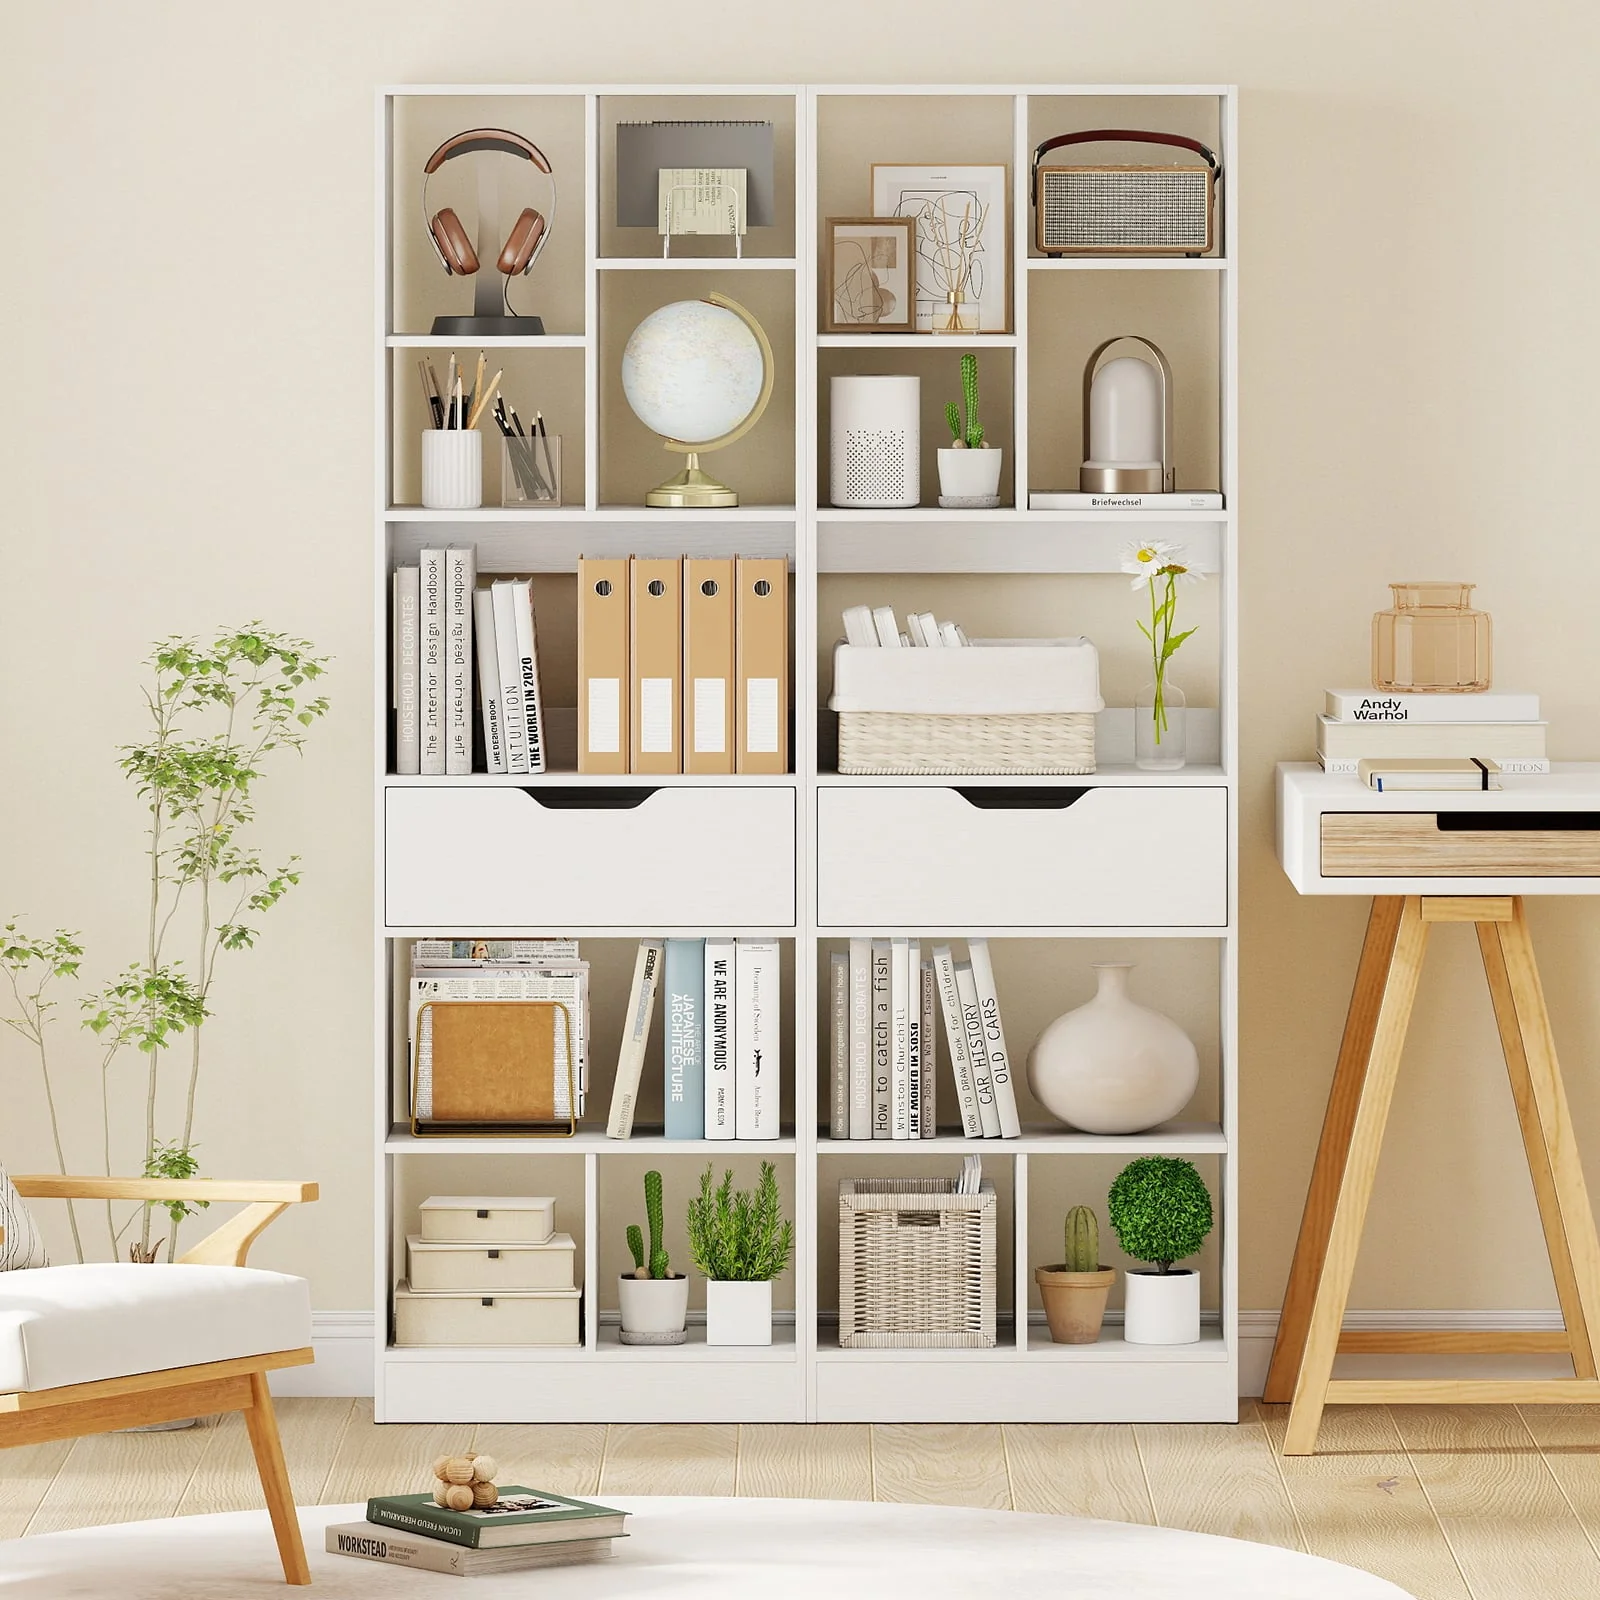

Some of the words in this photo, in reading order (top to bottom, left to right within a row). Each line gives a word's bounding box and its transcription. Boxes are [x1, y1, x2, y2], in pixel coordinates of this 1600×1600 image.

[1091, 498, 1142, 506] Briefwechsel
[426, 559, 437, 616] Handbook
[402, 595, 414, 665] DECORATES
[426, 622, 440, 665] Design
[520, 656, 534, 688] 2020
[402, 672, 414, 742] HOUSEHOLD
[426, 672, 437, 728] Interior
[522, 689, 536, 702] IN
[1360, 698, 1402, 711] Andy
[505, 684, 525, 768] INTUITION
[524, 703, 540, 745] WORLD
[1353, 709, 1409, 720] Warhol
[426, 735, 437, 756] The
[528, 746, 541, 768] THE
[714, 959, 727, 977] WE
[836, 966, 844, 988] house
[874, 957, 888, 992] fish
[714, 980, 727, 1000] ARE
[924, 970, 932, 1016] Isaacson
[940, 959, 955, 1008] children
[836, 992, 844, 1004] the
[856, 967, 866, 1034] DECORATES
[878, 1002, 888, 1012] a
[683, 994, 695, 1066] JAPANESE
[950, 1013, 960, 1031] for
[982, 998, 1001, 1041] CARS
[671, 993, 684, 1102] ARCHITECTURE
[714, 1003, 727, 1071] ANONYMOUS
[875, 1021, 888, 1066] catch
[896, 1008, 905, 1072] Churchill
[924, 1022, 932, 1056] Walter
[963, 1003, 987, 1068] HISTORY
[954, 1037, 965, 1061] Book
[837, 1071, 844, 1081] an
[856, 1042, 866, 1109] HOUSEHOLD
[924, 1061, 934, 1072] by
[959, 1066, 970, 1091] DRAW
[991, 1052, 1009, 1084] OLD
[836, 1085, 844, 1102] make
[876, 1076, 888, 1094] to
[924, 1078, 932, 1100] Jobs
[976, 1076, 993, 1105] CAR
[837, 1105, 844, 1115] to
[896, 1079, 905, 1130] Winston
[965, 1096, 973, 1108] TO
[836, 1118, 844, 1132] How
[875, 1103, 888, 1131] How
[924, 1106, 932, 1134] Steve
[968, 1114, 977, 1132] HOW
[380, 1509, 417, 1525] HERBARIUM
[417, 1520, 438, 1531] FREUD
[438, 1523, 462, 1537] LUCIAN
[338, 1534, 387, 1558] WORKSTEAD
